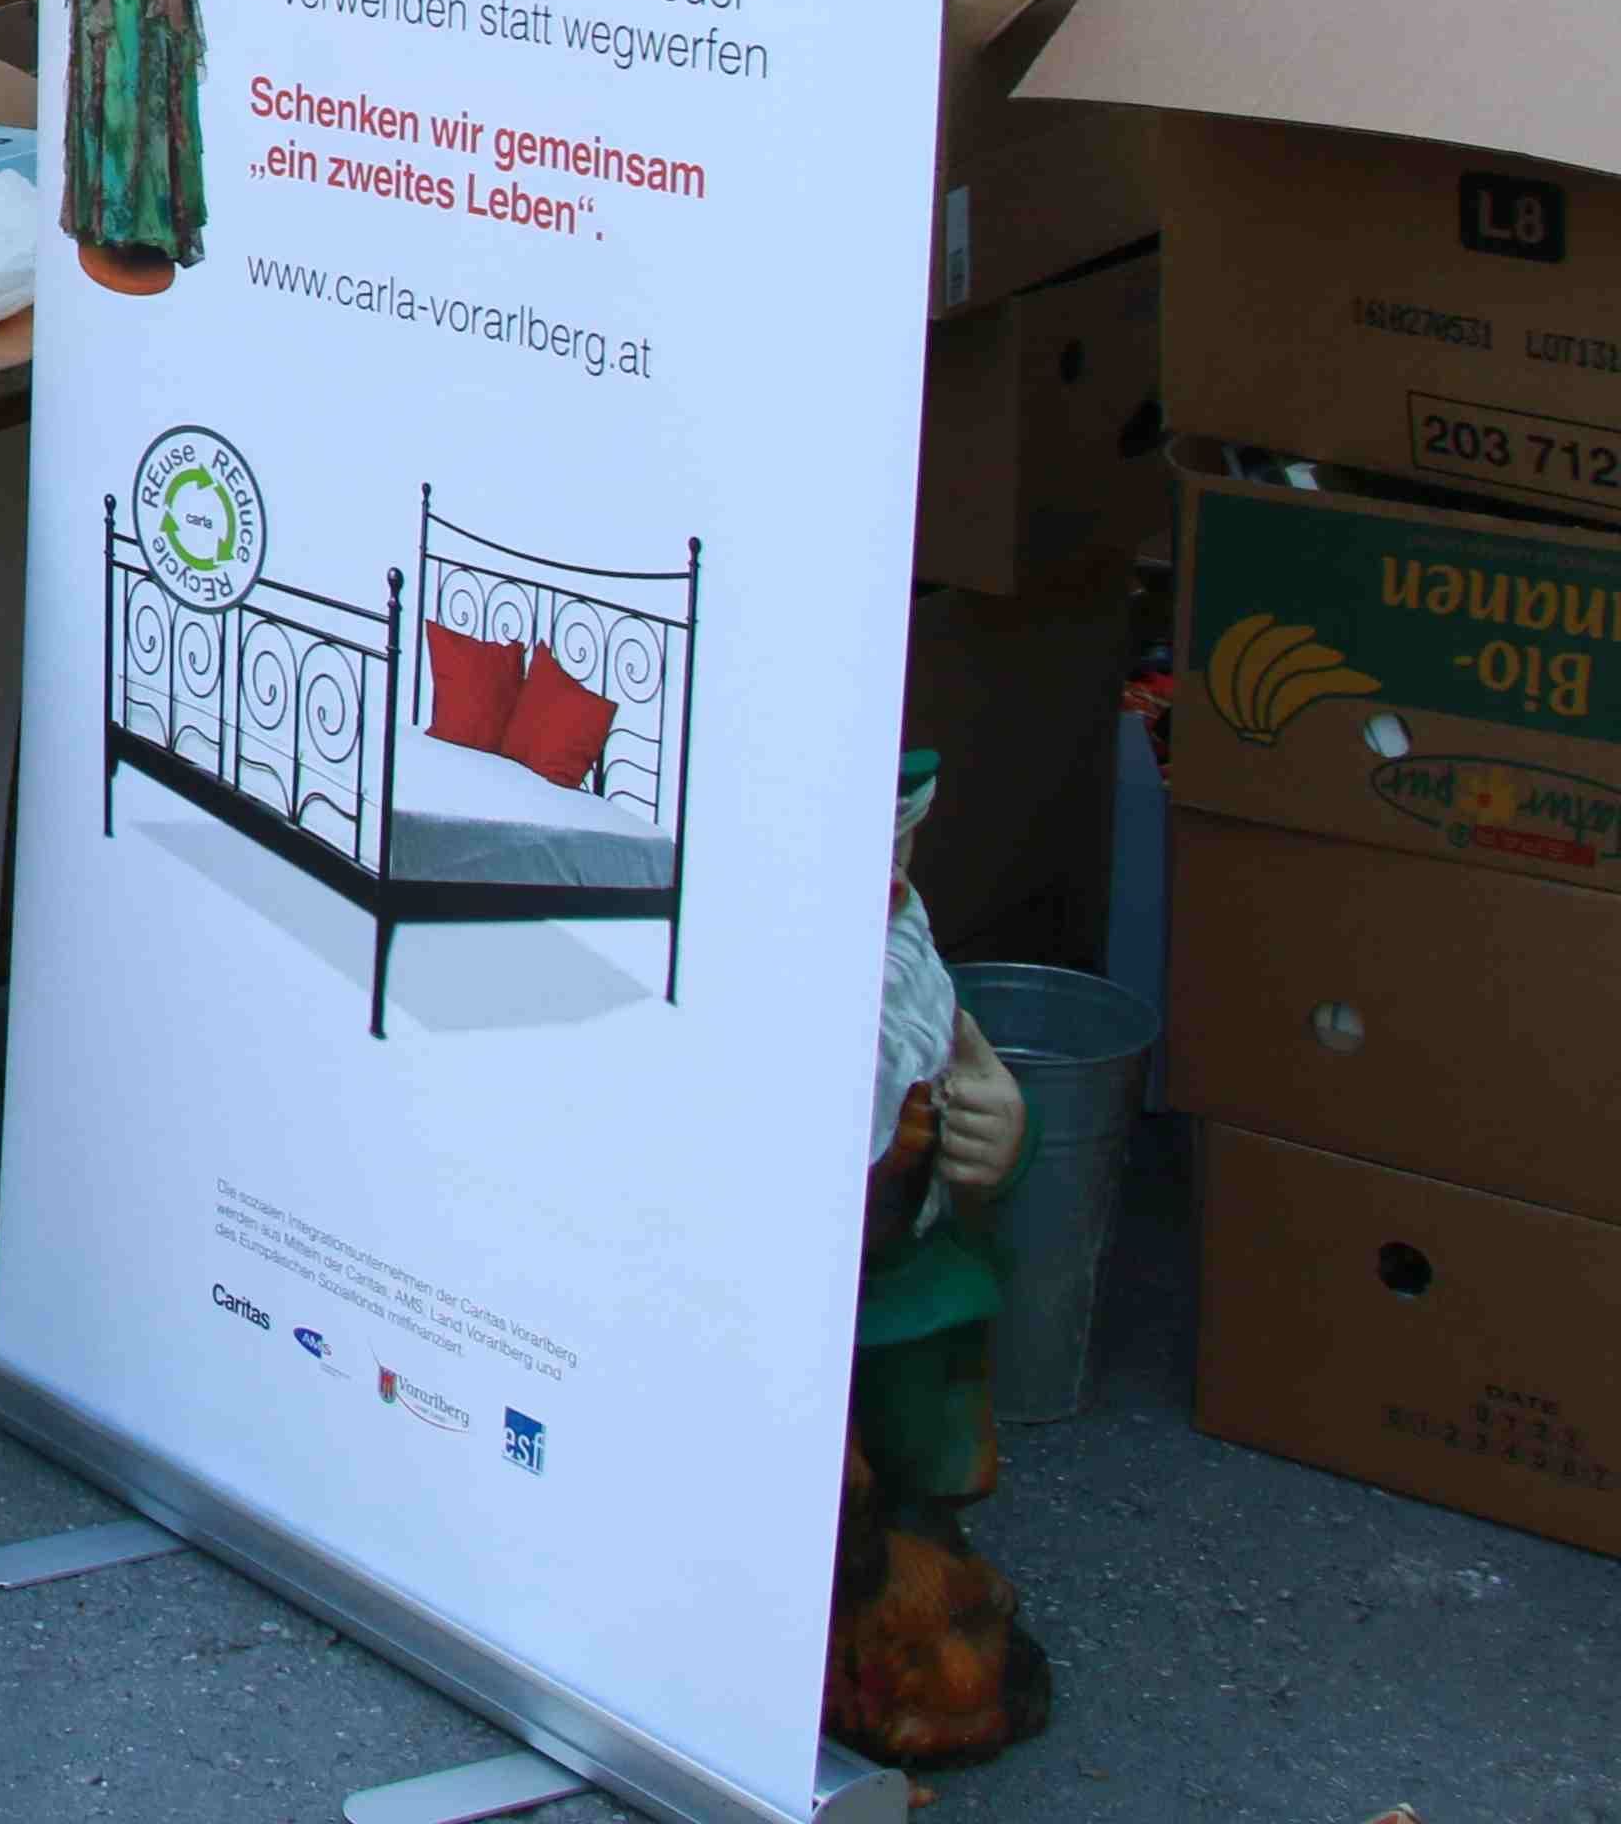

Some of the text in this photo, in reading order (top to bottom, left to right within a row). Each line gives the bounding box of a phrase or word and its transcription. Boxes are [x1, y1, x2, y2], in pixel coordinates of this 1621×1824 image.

[562, 13, 768, 79] wegwerfen
[250, 75, 705, 198] Schenken wir gemeinsam
[327, 154, 454, 210] zweites
[1479, 189, 1547, 245] L8
[247, 254, 652, 379] www.carla-vorarlberg.at
[1422, 414, 1620, 487] 203 712
[1381, 554, 1621, 642] nanen
[1453, 638, 1593, 718] Bio-
[212, 1283, 271, 1331] Caritas
[436, 1287, 457, 1306] der
[460, 1297, 506, 1331] Caritas
[510, 1319, 577, 1369] Vorarlberg
[466, 1323, 533, 1370] Vorarlberg
[397, 1375, 470, 1429] Vorarlberg
[505, 1426, 546, 1473] esf
